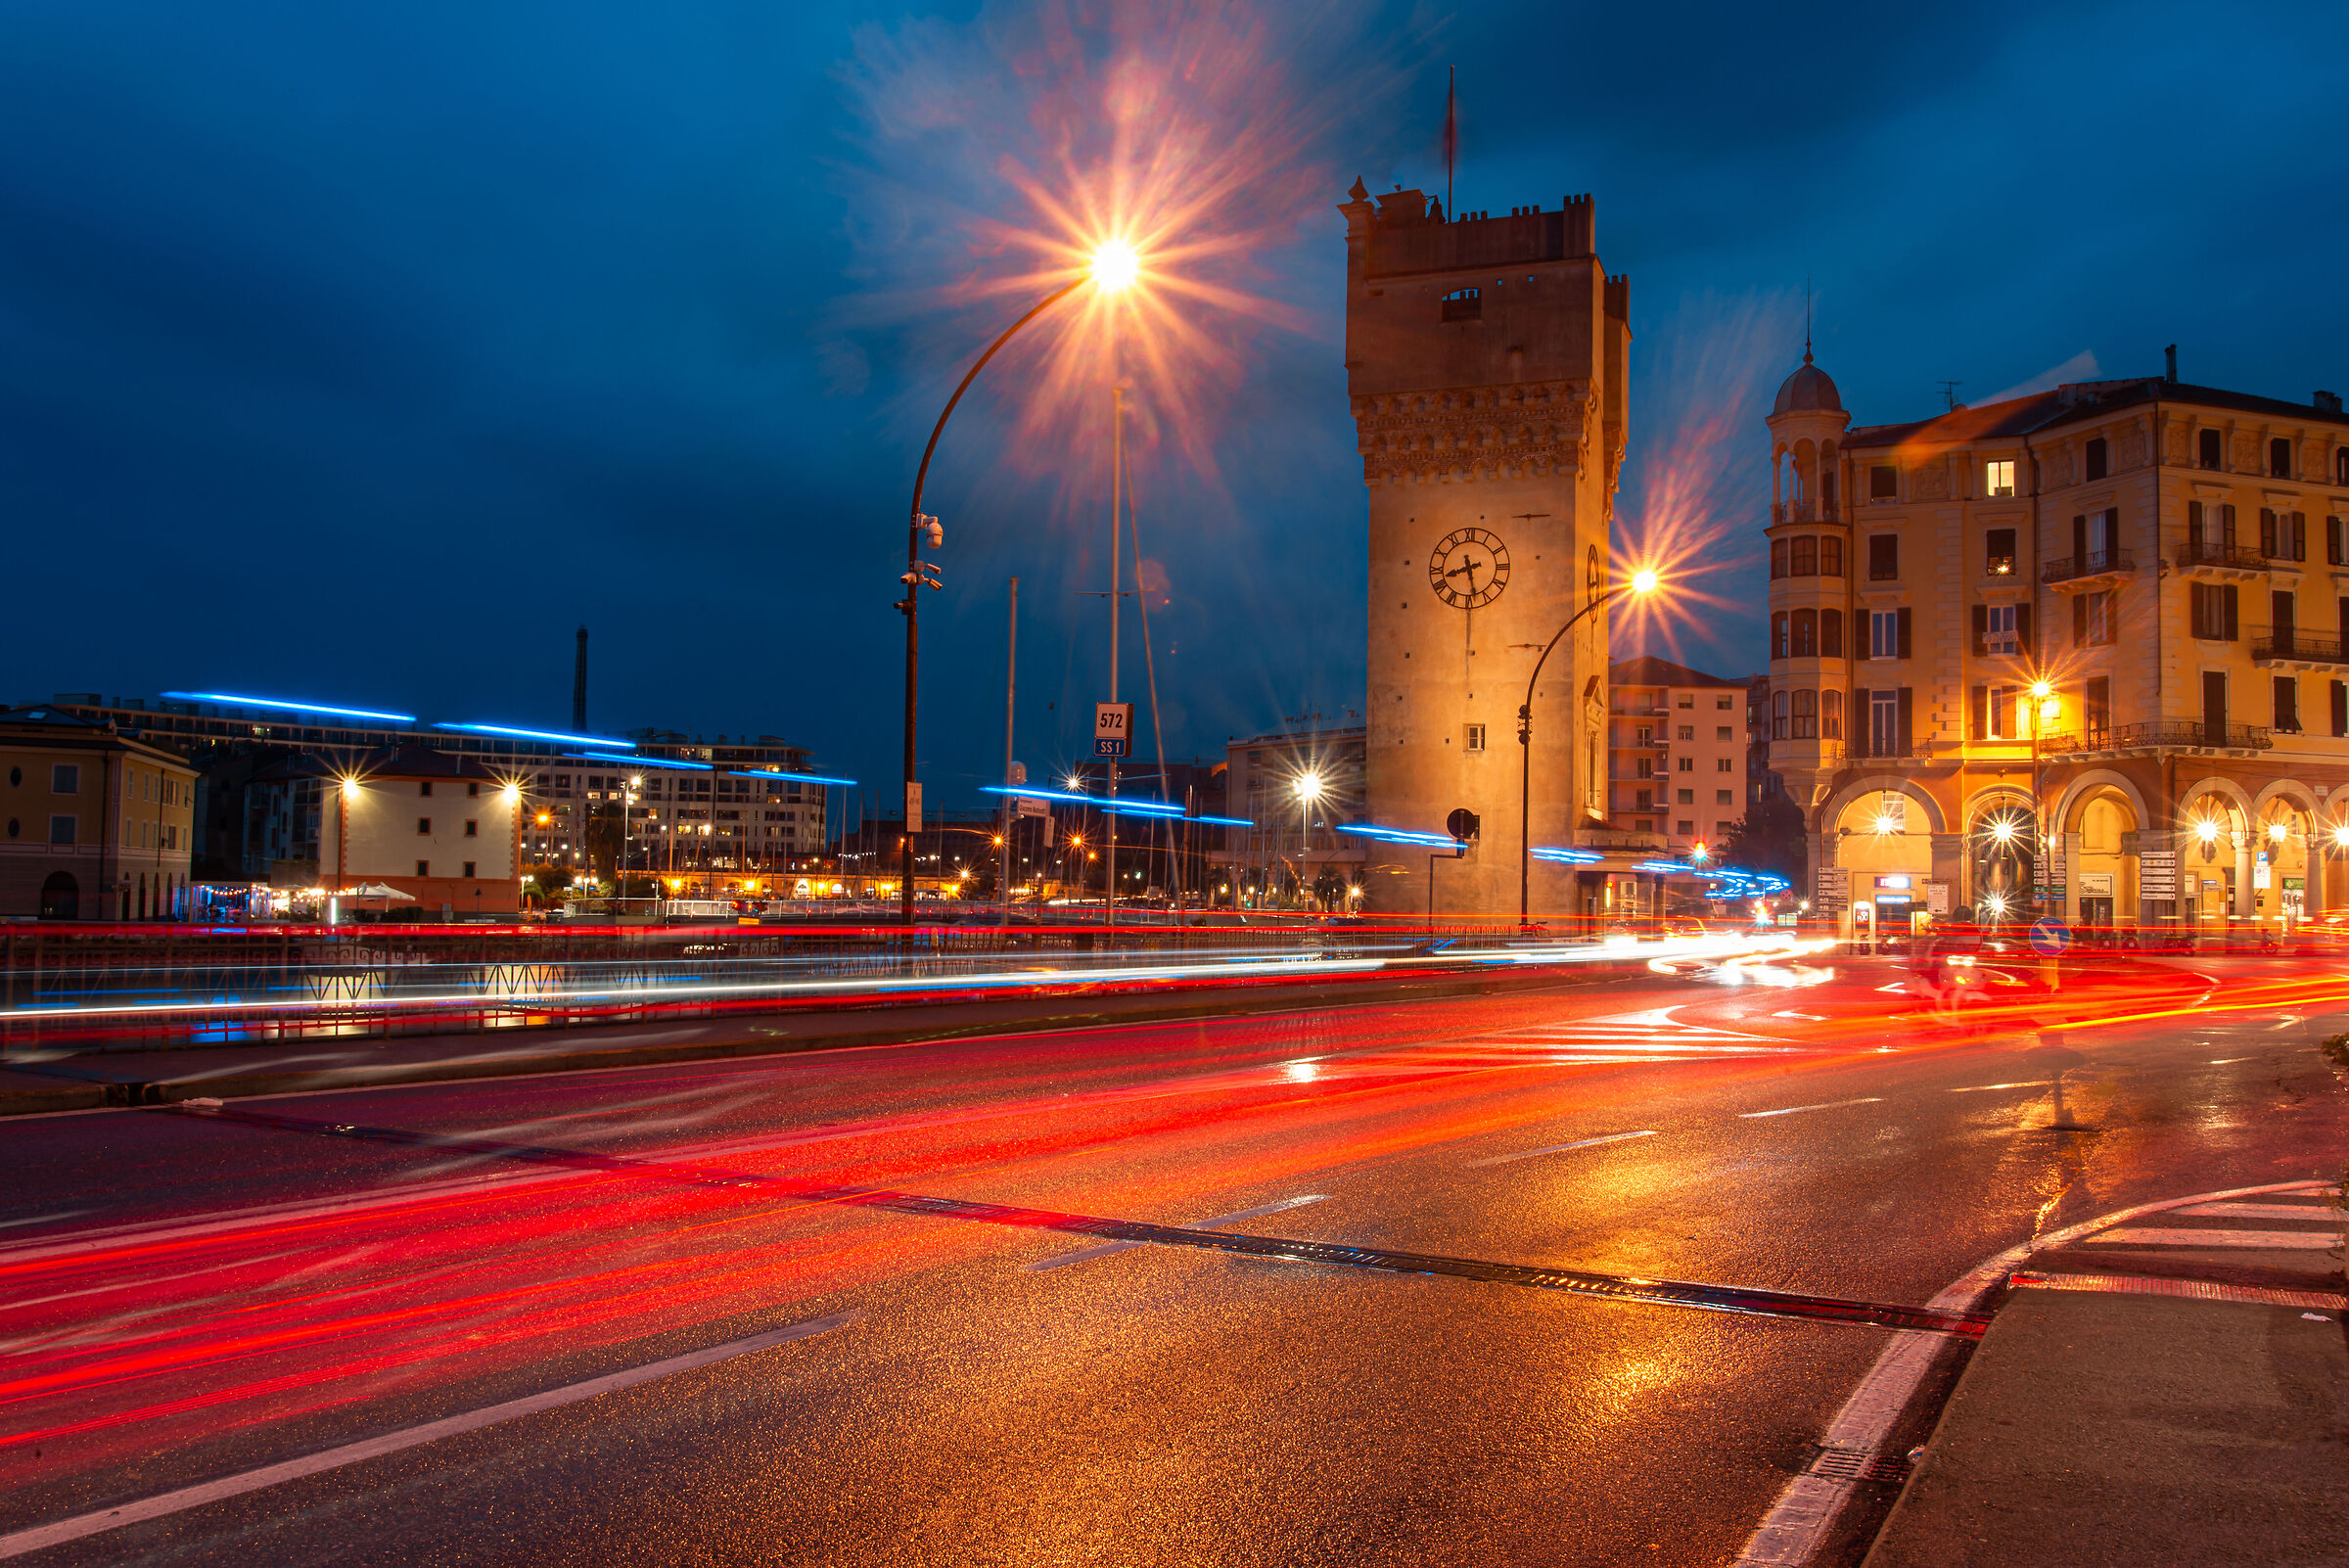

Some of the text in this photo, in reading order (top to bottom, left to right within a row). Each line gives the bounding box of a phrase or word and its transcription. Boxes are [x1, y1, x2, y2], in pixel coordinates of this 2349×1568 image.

[1465, 529, 1476, 542] XII
[1493, 545, 1505, 555] II
[1100, 714, 1123, 728] 572
[1101, 742, 1120, 753] SS 1
[2259, 853, 2266, 861] P
